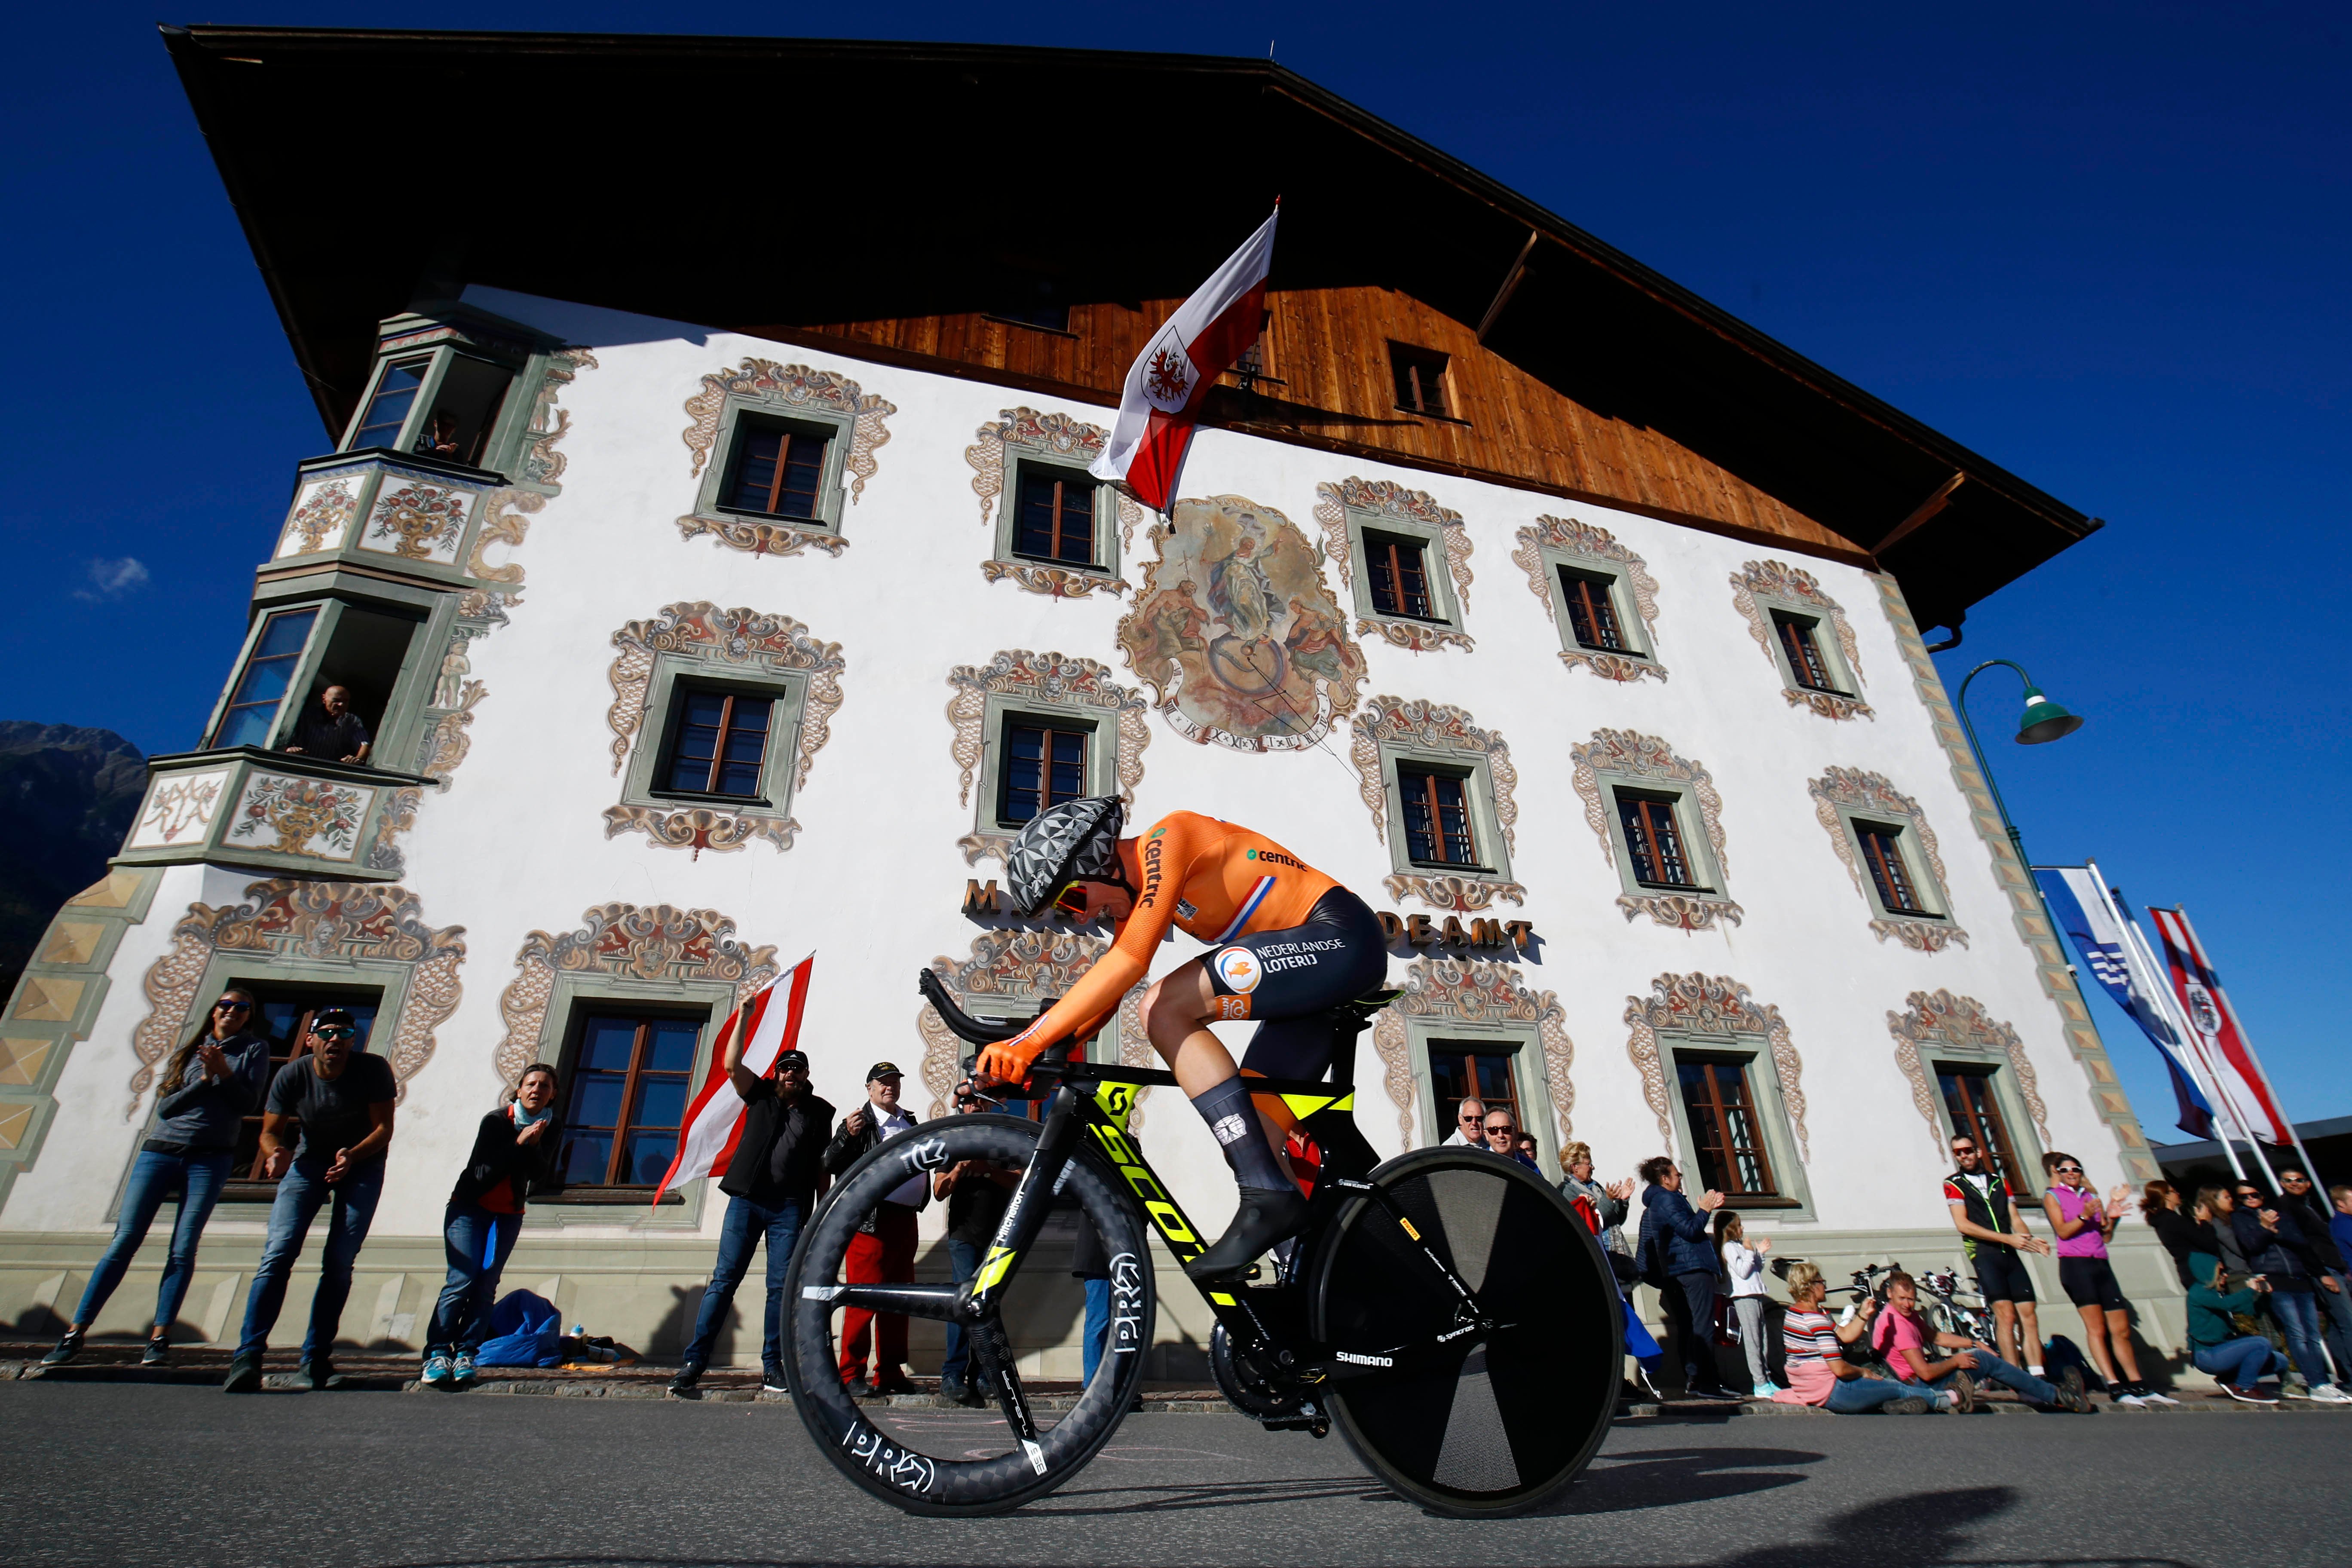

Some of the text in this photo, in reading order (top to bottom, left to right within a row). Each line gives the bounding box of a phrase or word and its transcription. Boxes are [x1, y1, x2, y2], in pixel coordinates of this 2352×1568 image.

[1259, 850, 1308, 872] centric
[1139, 839, 1162, 908] centric
[1375, 911, 1533, 951] DEAMT
[1256, 939, 1346, 959] NEDERLANDSE
[1263, 953, 1318, 974] LOTERIJ
[1336, 1351, 1393, 1367] SHIMANO
